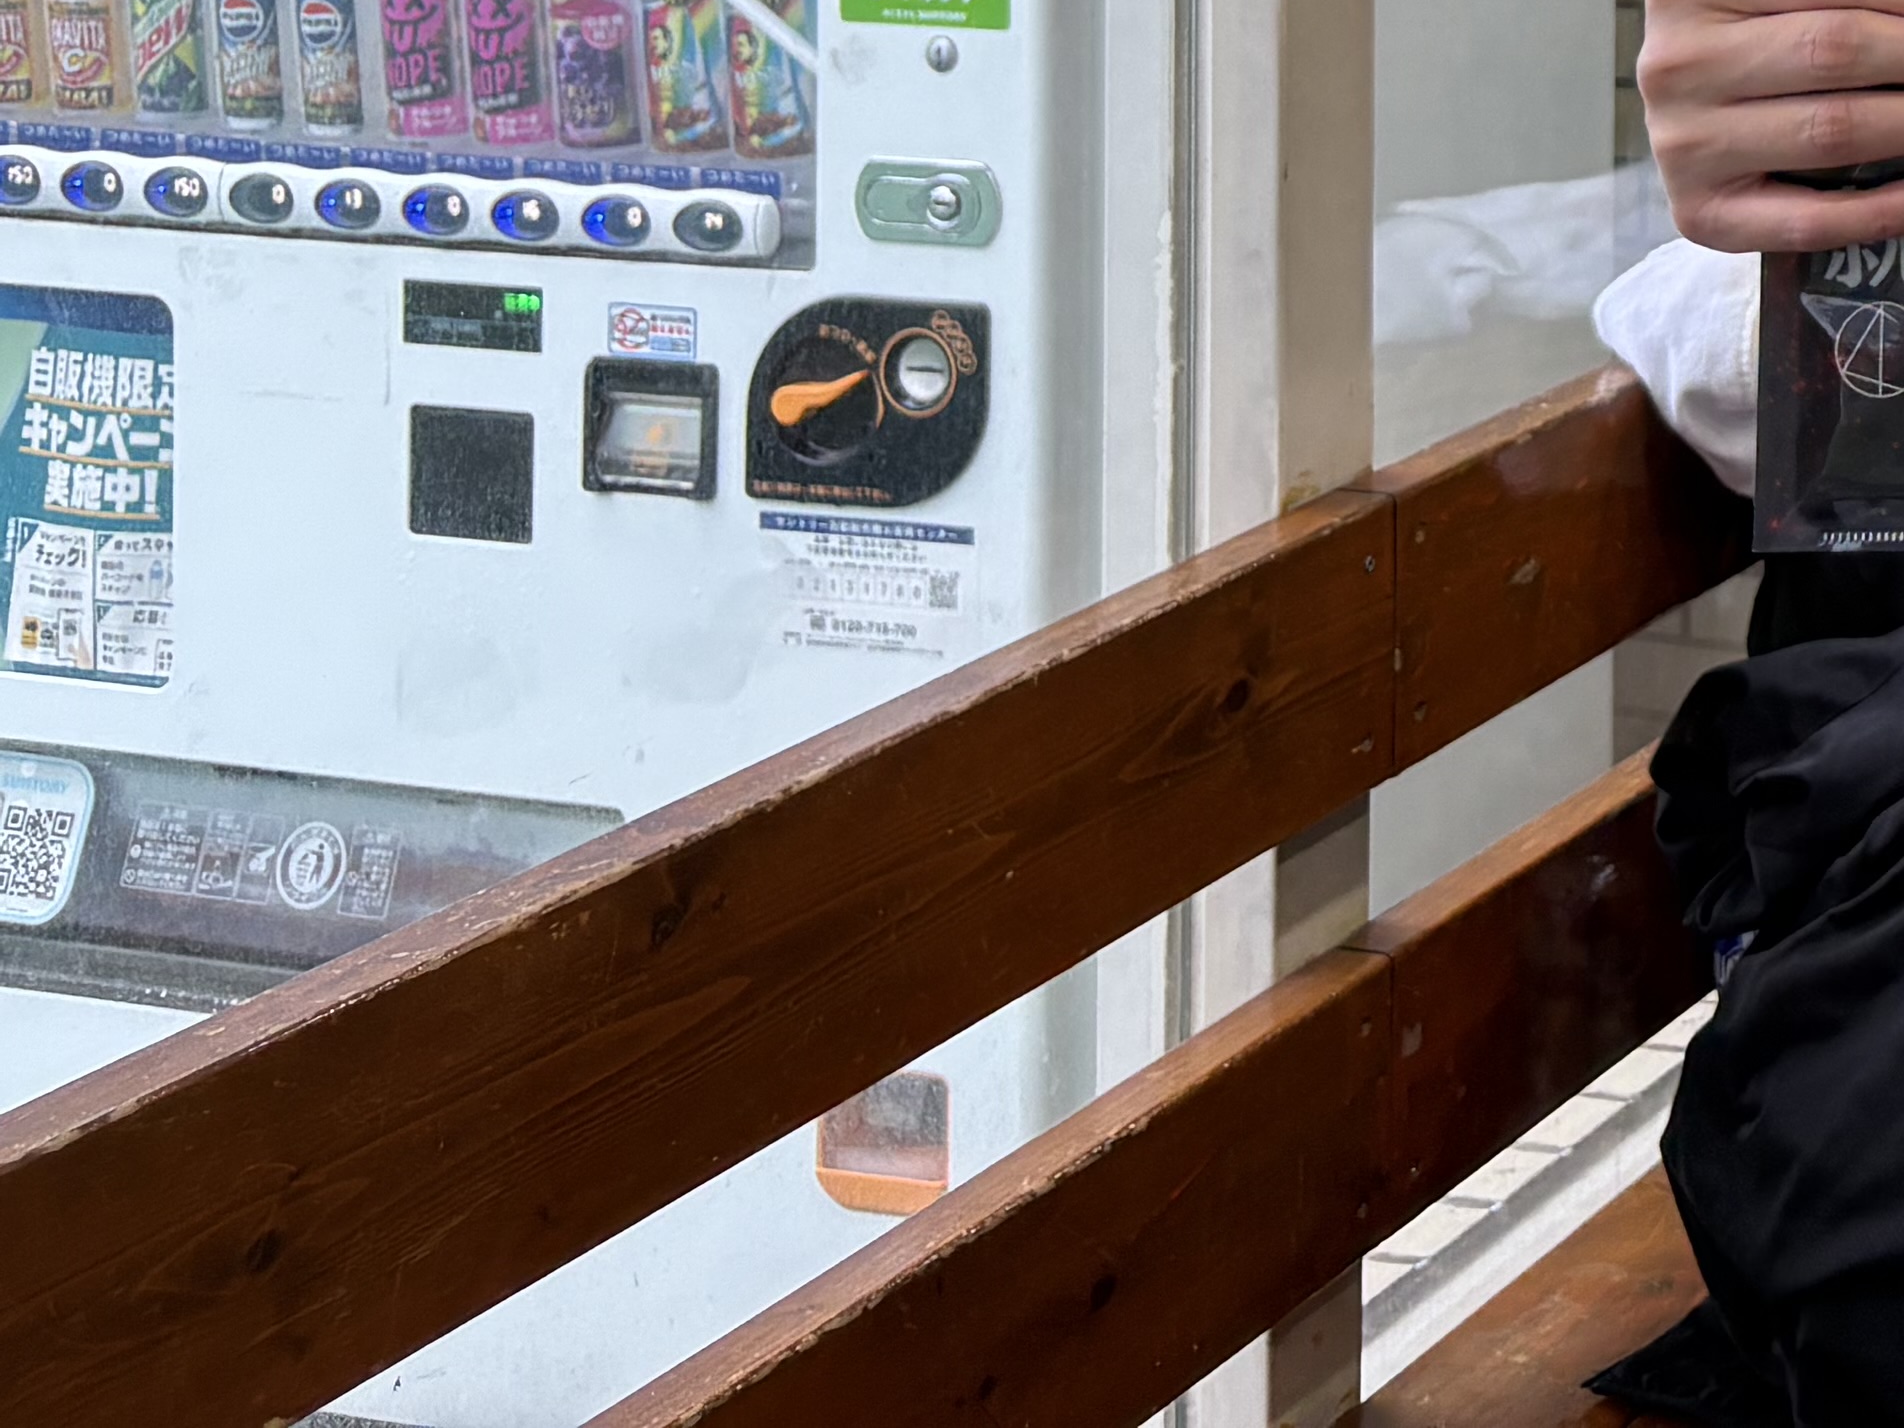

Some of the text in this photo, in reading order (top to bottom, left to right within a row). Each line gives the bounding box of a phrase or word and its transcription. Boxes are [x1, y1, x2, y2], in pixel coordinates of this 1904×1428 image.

[44, 459, 158, 515] 実施中!
[35, 544, 87, 569] チェック!
